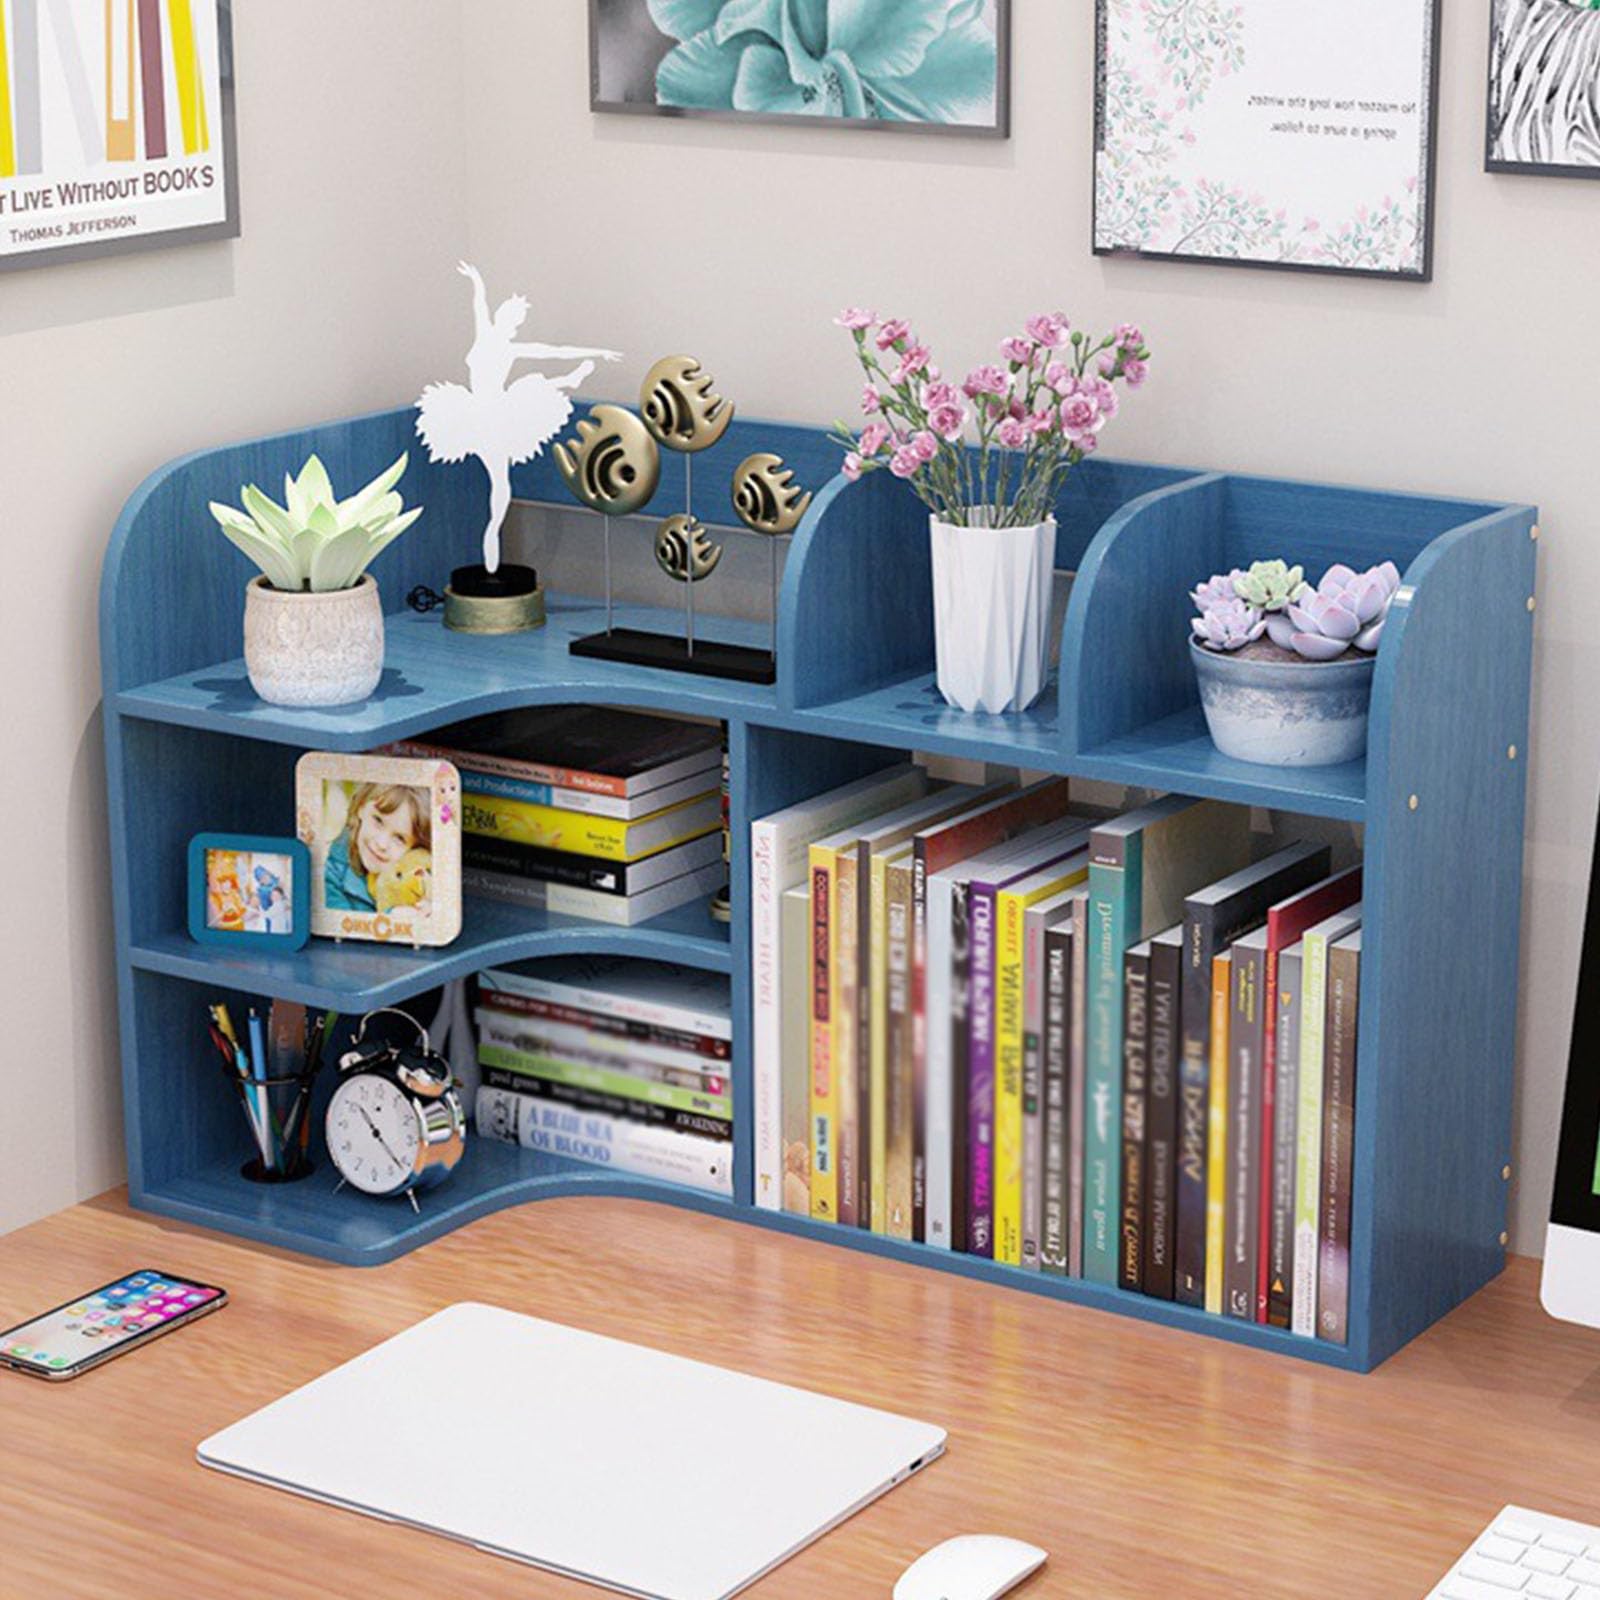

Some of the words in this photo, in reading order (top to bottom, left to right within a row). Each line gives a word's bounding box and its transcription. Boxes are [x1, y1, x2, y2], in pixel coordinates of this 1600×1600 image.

[12, 189, 53, 213] LIVE
[57, 178, 139, 206] WITHOUT
[10, 226, 63, 243] THOMAS
[66, 215, 137, 237] JEFFERSON
